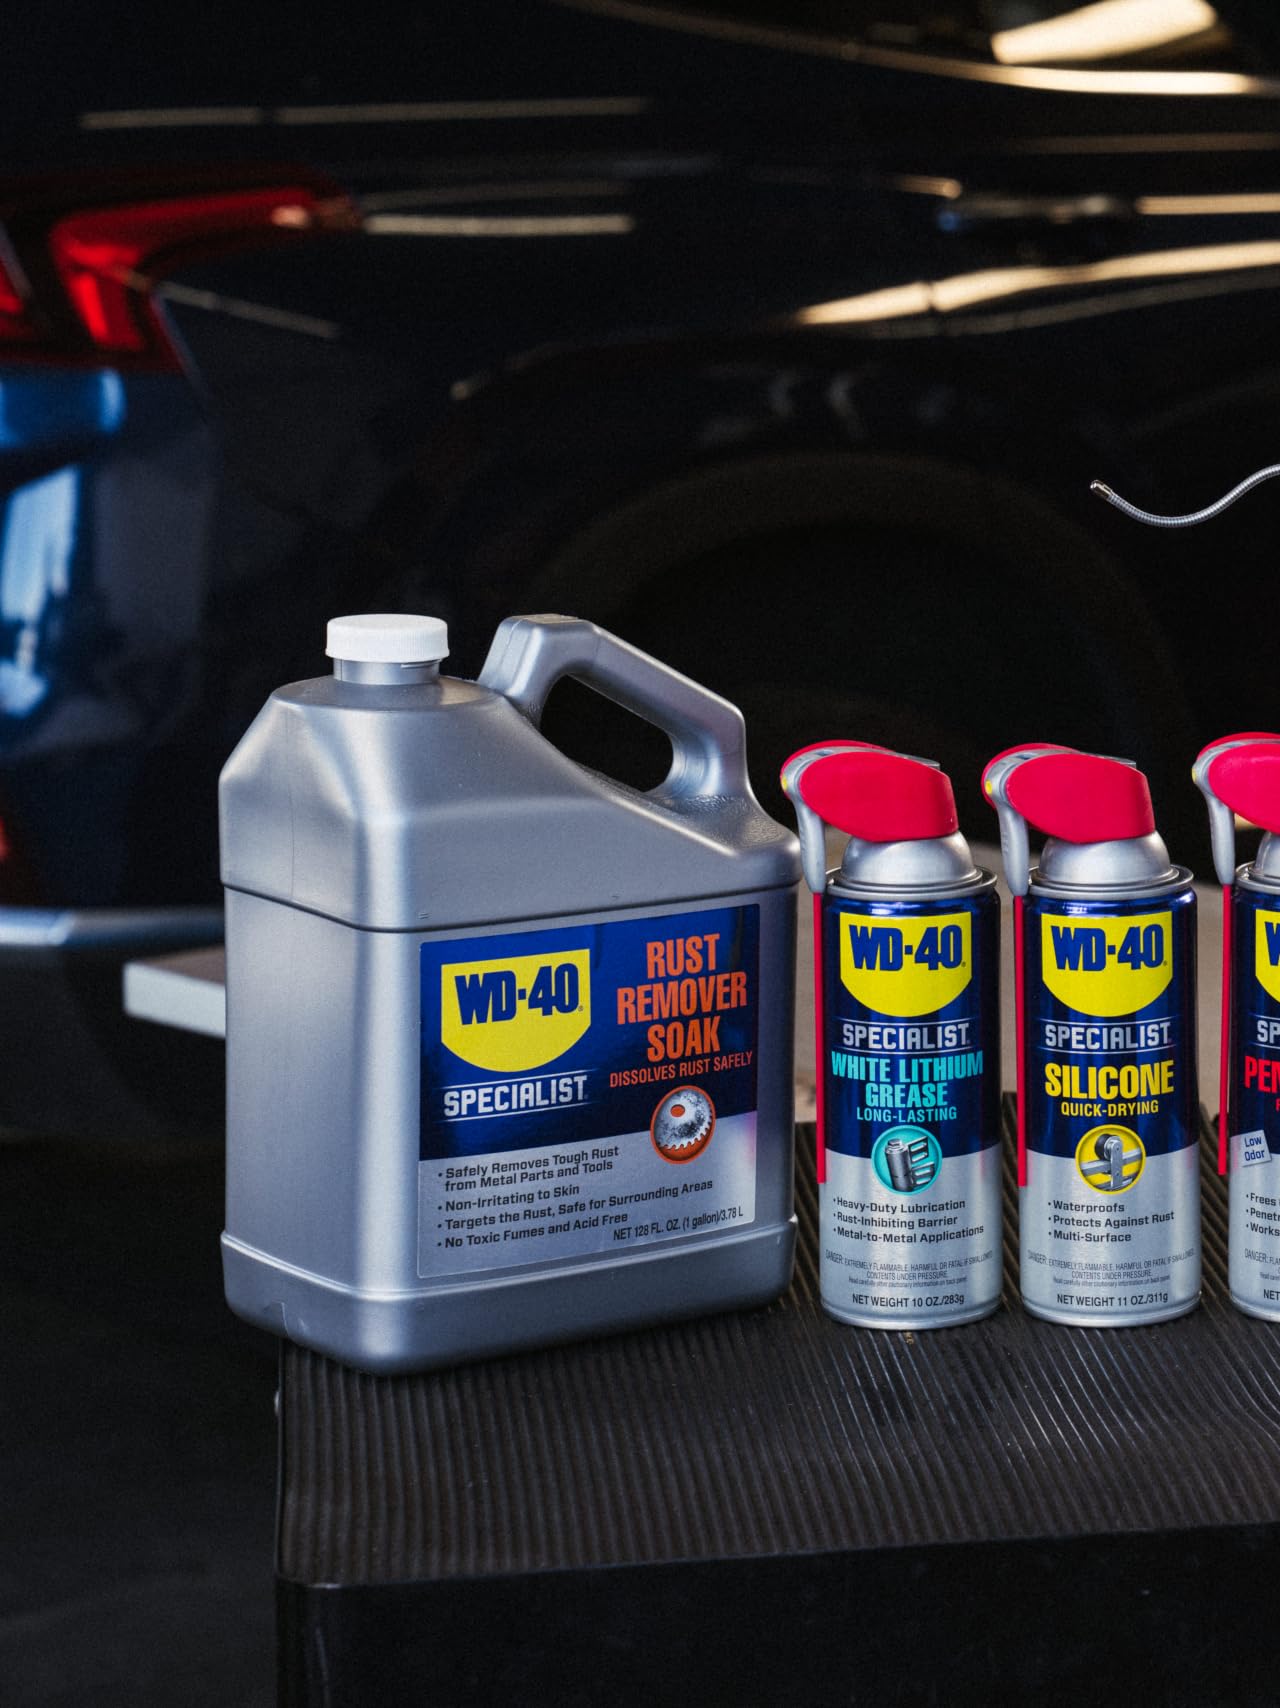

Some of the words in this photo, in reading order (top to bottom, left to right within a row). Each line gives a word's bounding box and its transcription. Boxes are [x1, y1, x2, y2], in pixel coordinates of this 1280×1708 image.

[647, 933, 720, 978] RUST
[849, 925, 962, 971] WD-40
[1051, 924, 1164, 972] WD-40
[455, 963, 579, 1026] WD-40
[617, 972, 747, 1024] REMOVER
[647, 1016, 721, 1062] SOAK
[843, 1023, 970, 1050] SPECIALIST
[1045, 1022, 1170, 1050] SPECIALIST
[609, 1064, 676, 1088] DISSOLVES
[679, 1059, 710, 1076] RUST
[713, 1051, 753, 1072] SAFELY
[831, 1051, 890, 1082] WHITE
[899, 1051, 983, 1083] LITHIUM
[1045, 1060, 1174, 1100] SILICONE
[444, 1075, 588, 1116] SPECIALIST
[865, 1083, 948, 1108] GREASE
[1061, 1100, 1159, 1117] QUICK-DRYING
[857, 1107, 957, 1124] LONG-LASTING
[1244, 1135, 1262, 1148] Low
[446, 1165, 488, 1178] Safely
[492, 1158, 549, 1173] Removes
[552, 1151, 588, 1164] Tough
[592, 1146, 619, 1159] Rust
[1244, 1149, 1265, 1162] Odor
[445, 1181, 476, 1191] from
[480, 1173, 517, 1188] Metal
[521, 1169, 554, 1183] Parts
[558, 1164, 578, 1177] and
[582, 1160, 612, 1174] Tools
[445, 1193, 534, 1211] Non-Irritating
[537, 1190, 550, 1200] to
[554, 1185, 580, 1197] Skin
[445, 1215, 496, 1230] Targets
[500, 1212, 519, 1223] the
[523, 1207, 555, 1220] Rust,
[558, 1202, 585, 1215] Safe
[589, 1199, 606, 1210] for
[609, 1186, 678, 1206] Surrounding
[681, 1181, 713, 1193] Areas
[837, 1197, 897, 1214] Heavy-Duty
[900, 1199, 965, 1214] Lubrication
[1053, 1200, 1125, 1213] Waterproofs
[1250, 1193, 1276, 1206] Frees
[445, 1238, 463, 1248] No
[467, 1232, 500, 1245] Toxic
[503, 1227, 544, 1241] Fumes
[548, 1222, 570, 1234] and
[573, 1216, 598, 1230] Acid
[602, 1213, 628, 1225] Free
[613, 1227, 631, 1240] NET
[635, 1225, 648, 1237] 128
[651, 1222, 664, 1234] FL.
[667, 1218, 681, 1232] OZ.
[683, 1217, 690, 1232] (1
[738, 1206, 743, 1217] L
[837, 1212, 915, 1230] Rust-Inhibiting
[918, 1216, 958, 1228] Barrier
[1053, 1215, 1101, 1228] Protects
[1105, 1215, 1149, 1229] Against
[1152, 1211, 1174, 1224] Rust
[1250, 1223, 1280, 1237] Works
[837, 1226, 916, 1243] Metal-to-Metal
[920, 1225, 984, 1244] Applications
[1053, 1230, 1132, 1242] Multi-Surface
[853, 1294, 870, 1305] NET
[871, 1295, 908, 1307] WEIGHT
[912, 1298, 923, 1307] 10
[926, 1294, 964, 1307] OZ./283g
[1057, 1294, 1074, 1305] NET
[1076, 1295, 1114, 1307] WEIGHT
[1118, 1298, 1127, 1306] 11
[1131, 1293, 1168, 1306] OZ./311g
[1264, 1289, 1280, 1300] NET
